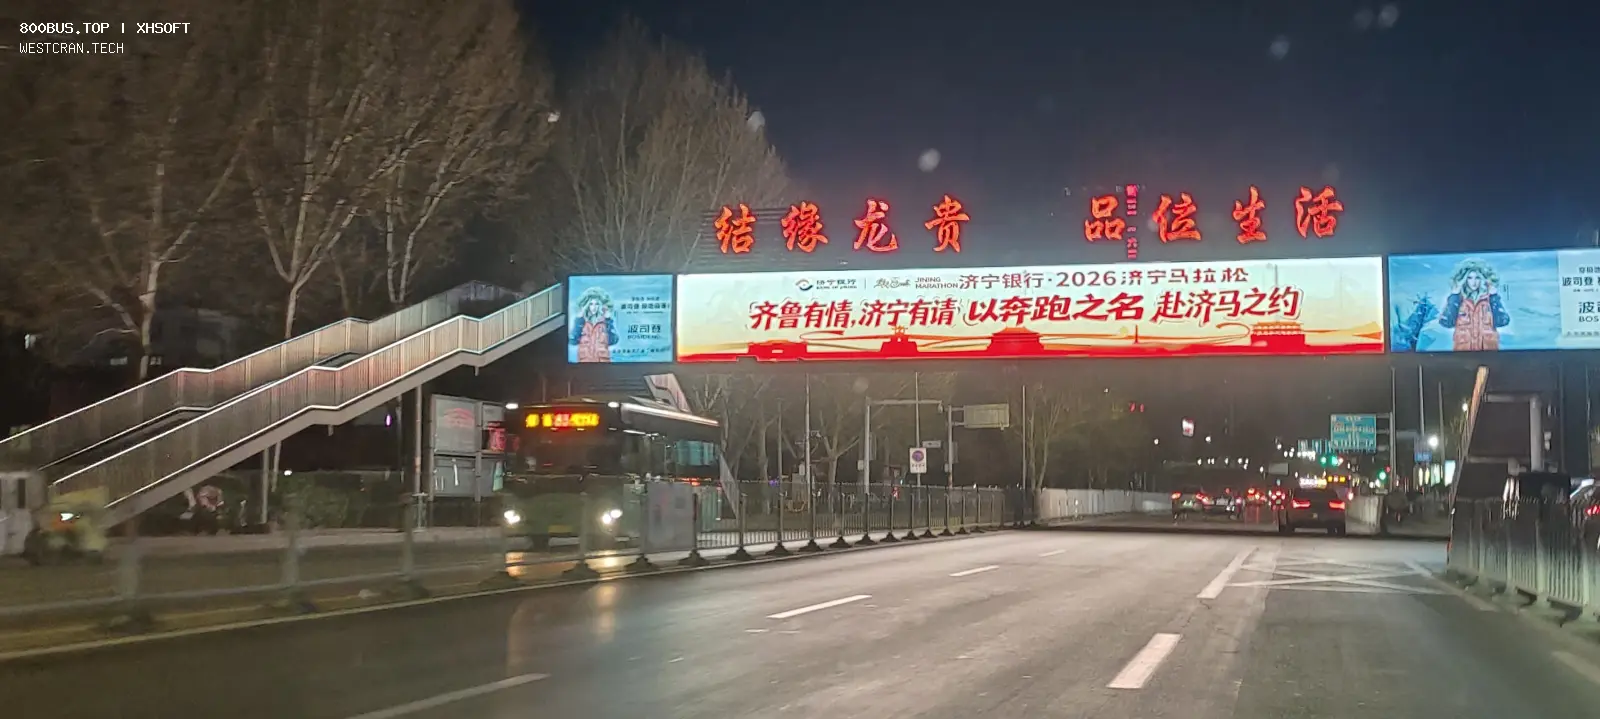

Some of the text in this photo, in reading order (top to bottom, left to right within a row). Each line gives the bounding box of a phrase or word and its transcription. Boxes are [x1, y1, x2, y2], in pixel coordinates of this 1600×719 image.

[713, 194, 971, 254] 结缘龙贵
[1084, 185, 1344, 243] 品位生活
[915, 282, 959, 290] MARATHON
[967, 291, 1145, 327] 以奔跑之名
[1149, 286, 1301, 325] 赴济马之约
[1578, 302, 1600, 314] 波
